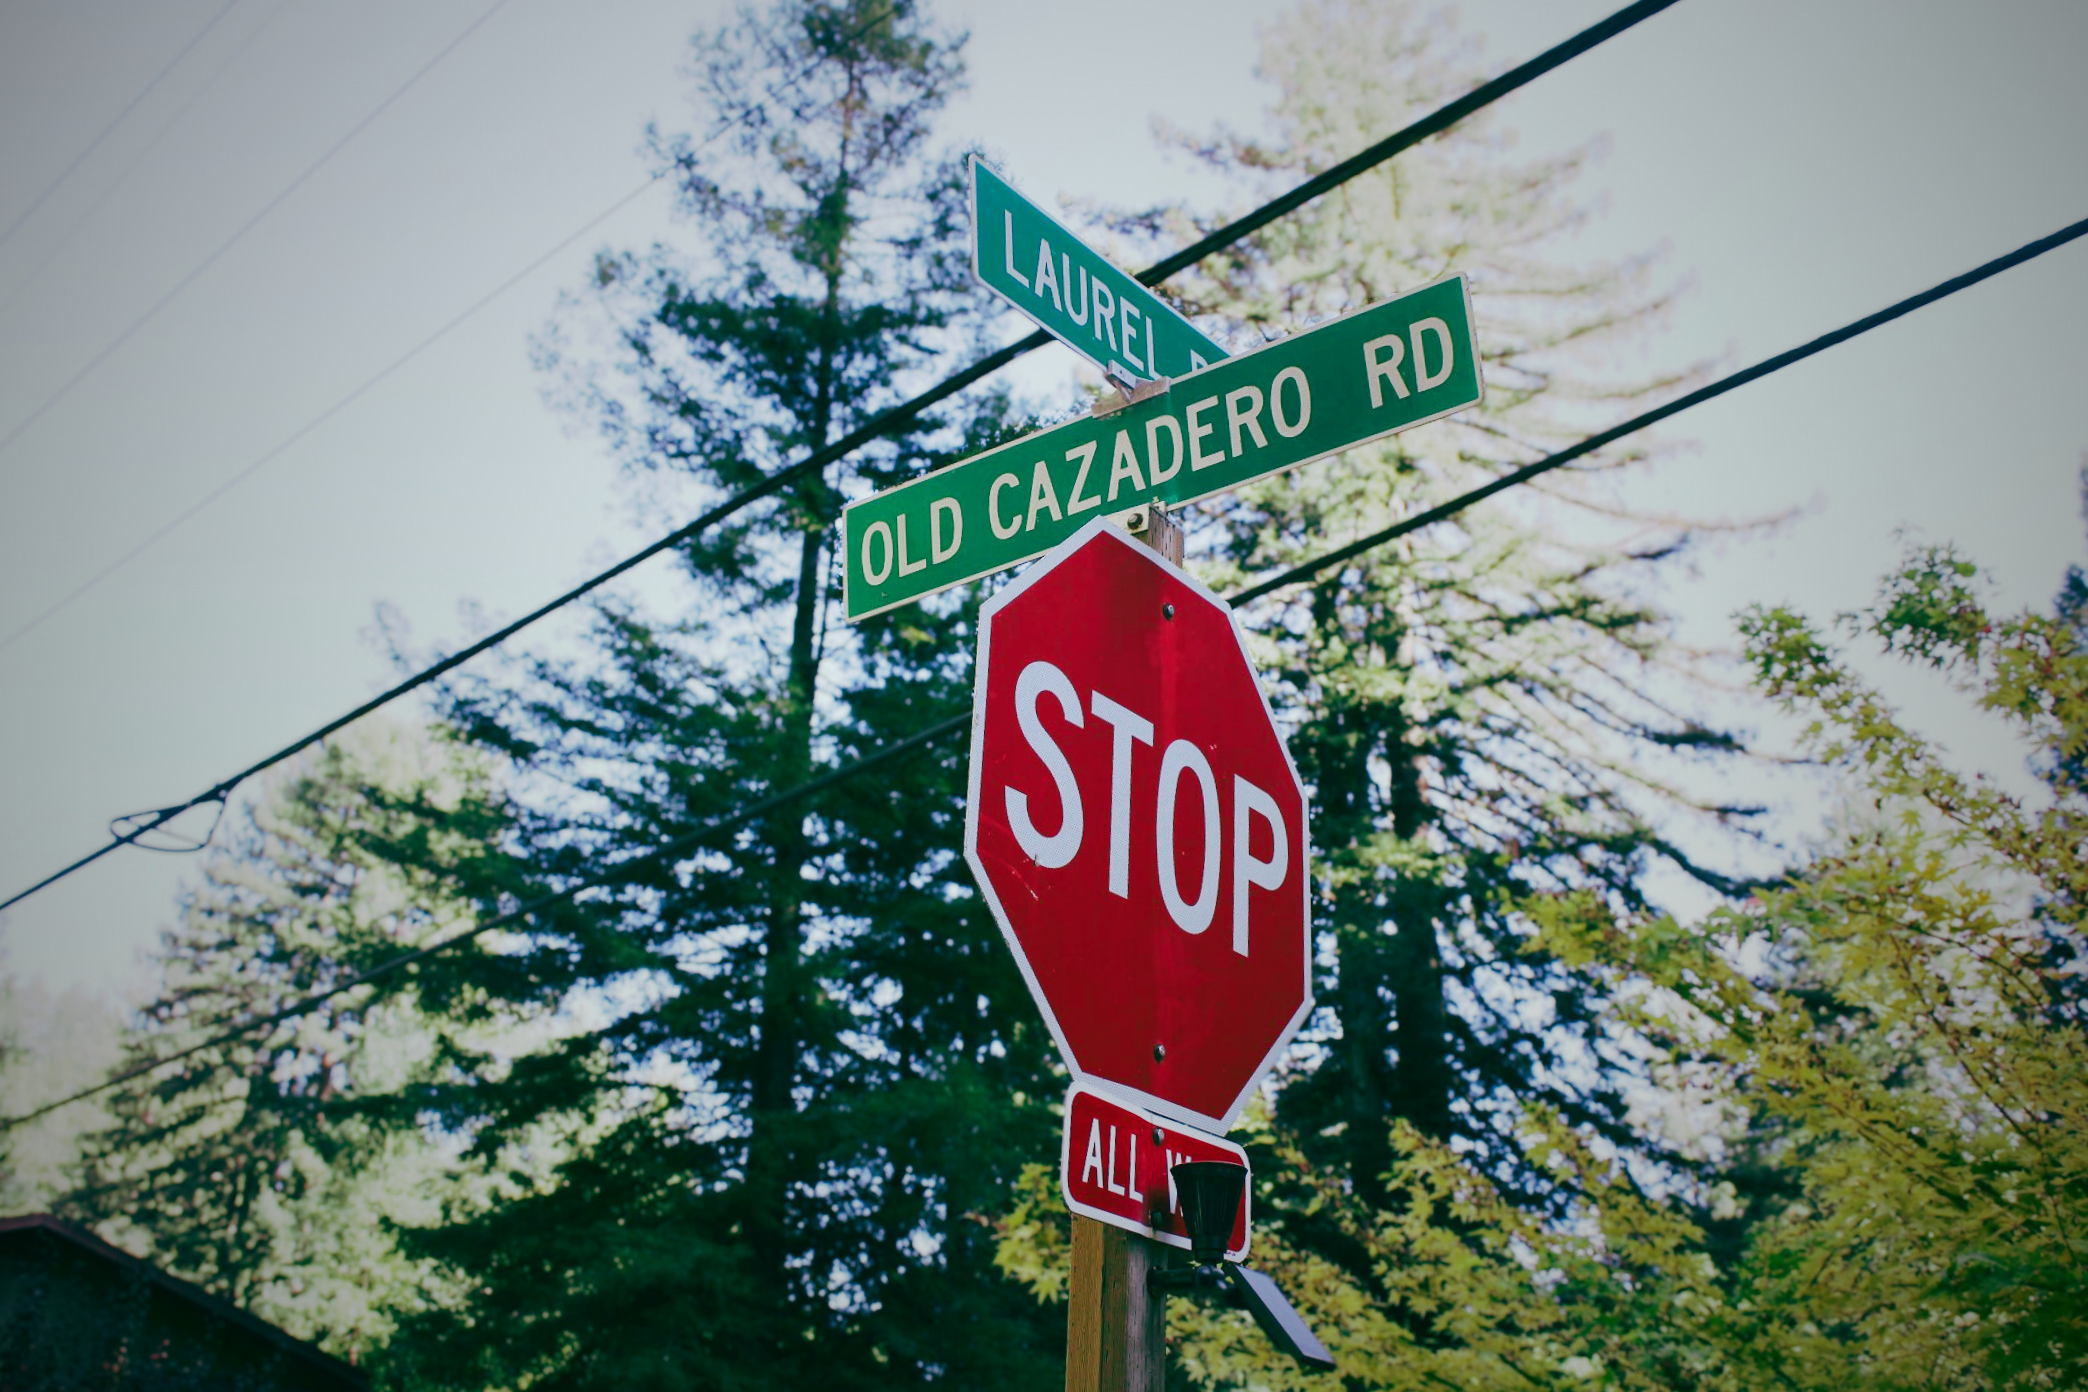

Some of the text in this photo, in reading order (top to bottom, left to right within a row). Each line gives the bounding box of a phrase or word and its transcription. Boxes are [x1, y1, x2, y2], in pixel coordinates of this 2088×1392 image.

[1004, 209, 1163, 380] LAUREL
[861, 317, 1454, 586] OLD CAZADERO RD
[1004, 660, 1289, 958] STOP
[1081, 1118, 1144, 1203] ALL
